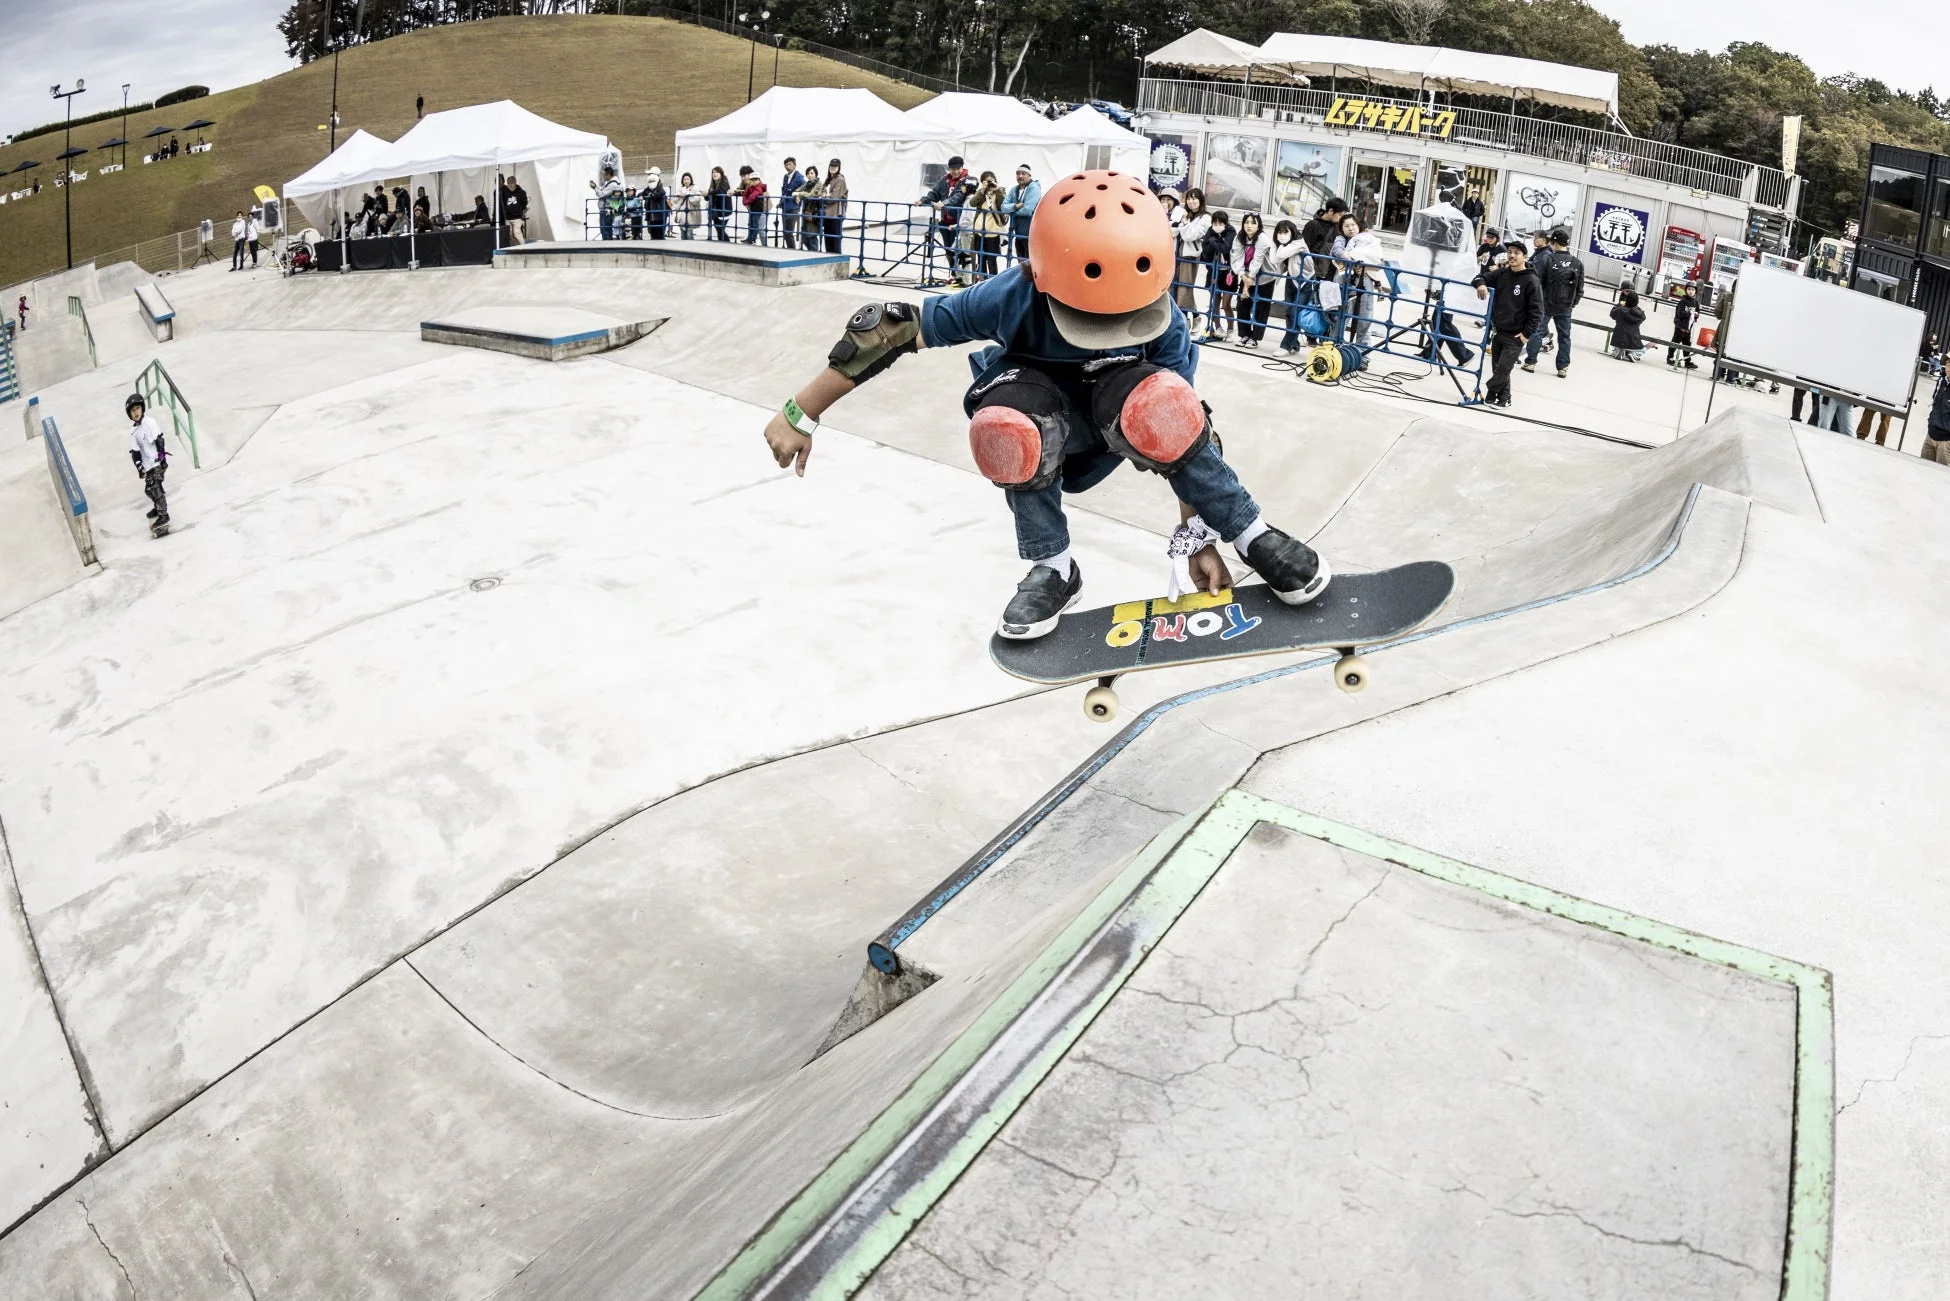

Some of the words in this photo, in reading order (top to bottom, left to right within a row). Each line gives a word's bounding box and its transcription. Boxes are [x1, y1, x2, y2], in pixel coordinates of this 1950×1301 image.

[1324, 98, 1457, 138] ムラサキパーク
[1144, 601, 1153, 629] MAGICAL
